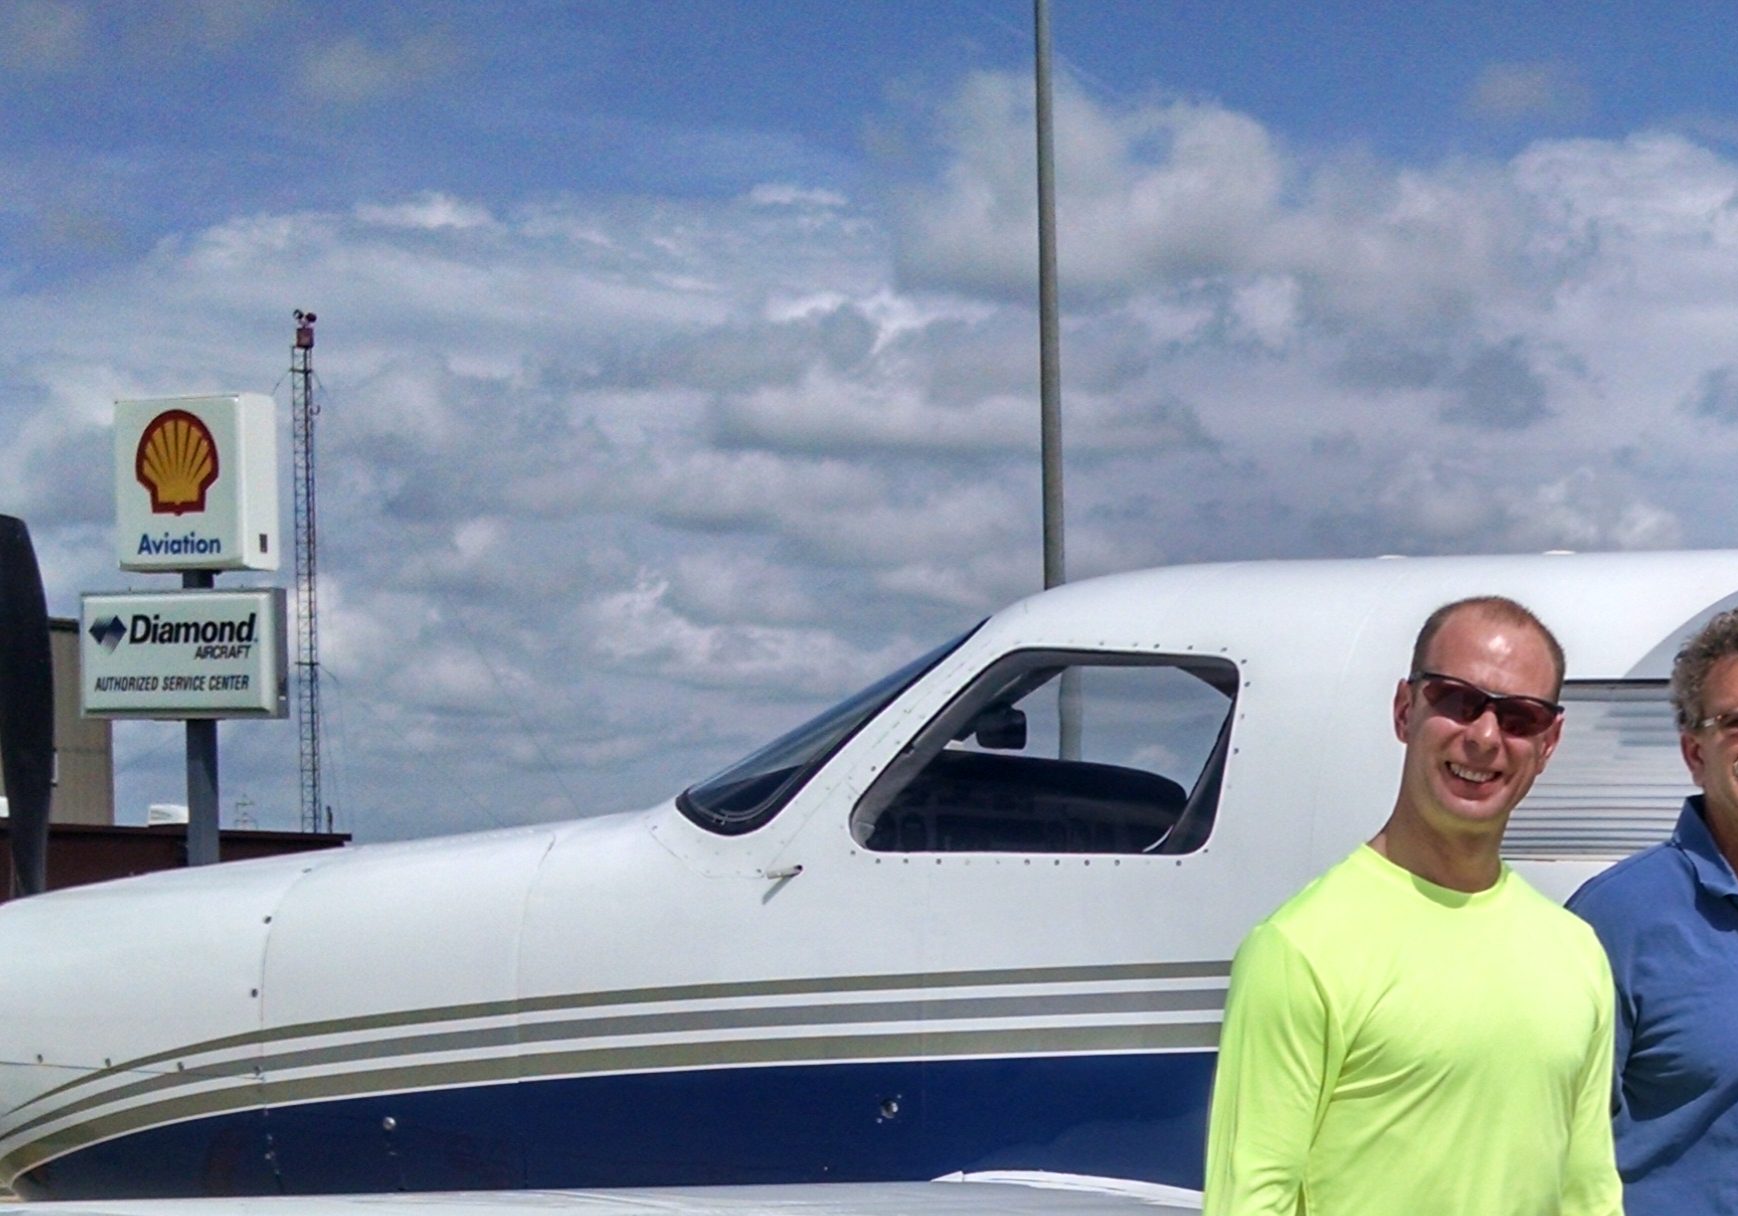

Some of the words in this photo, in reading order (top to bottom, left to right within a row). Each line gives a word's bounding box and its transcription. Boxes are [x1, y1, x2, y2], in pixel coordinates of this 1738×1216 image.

[138, 531, 221, 555] Aviation
[129, 613, 256, 644] Diamond
[195, 645, 251, 660] AIRCRAFT
[95, 676, 158, 692] AUTHORIZED
[162, 675, 205, 691] SERVICE
[209, 675, 249, 690] CENTER
